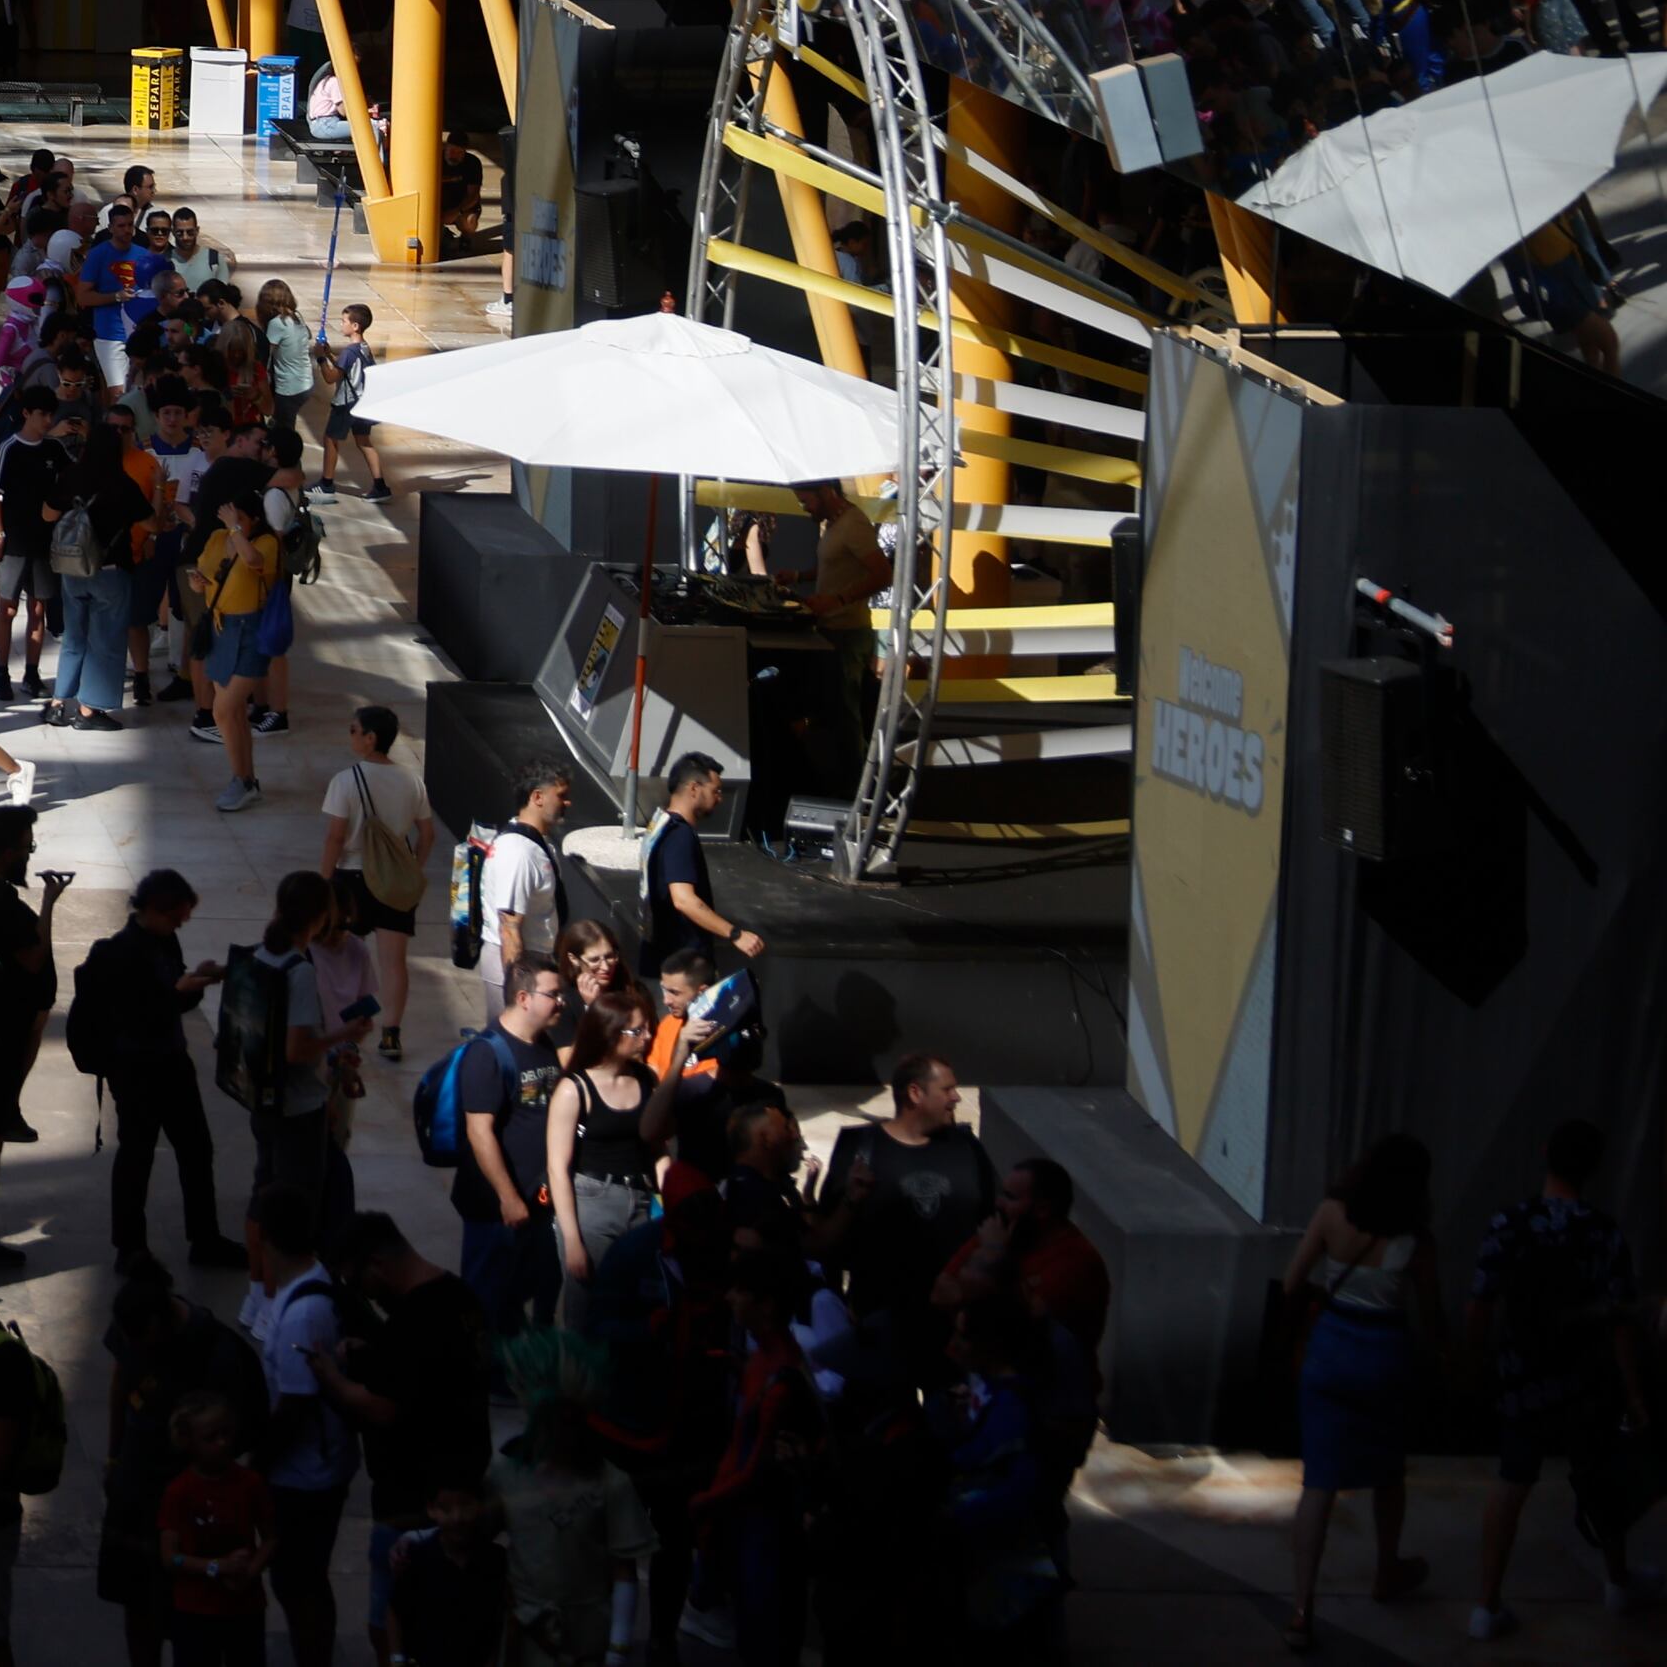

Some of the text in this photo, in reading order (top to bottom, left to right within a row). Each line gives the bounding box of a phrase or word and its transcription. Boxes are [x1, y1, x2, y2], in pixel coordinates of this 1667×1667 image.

[150, 68, 160, 119] SEPARA
[282, 77, 292, 119] EPARA
[1152, 698, 1265, 812] HEROES
